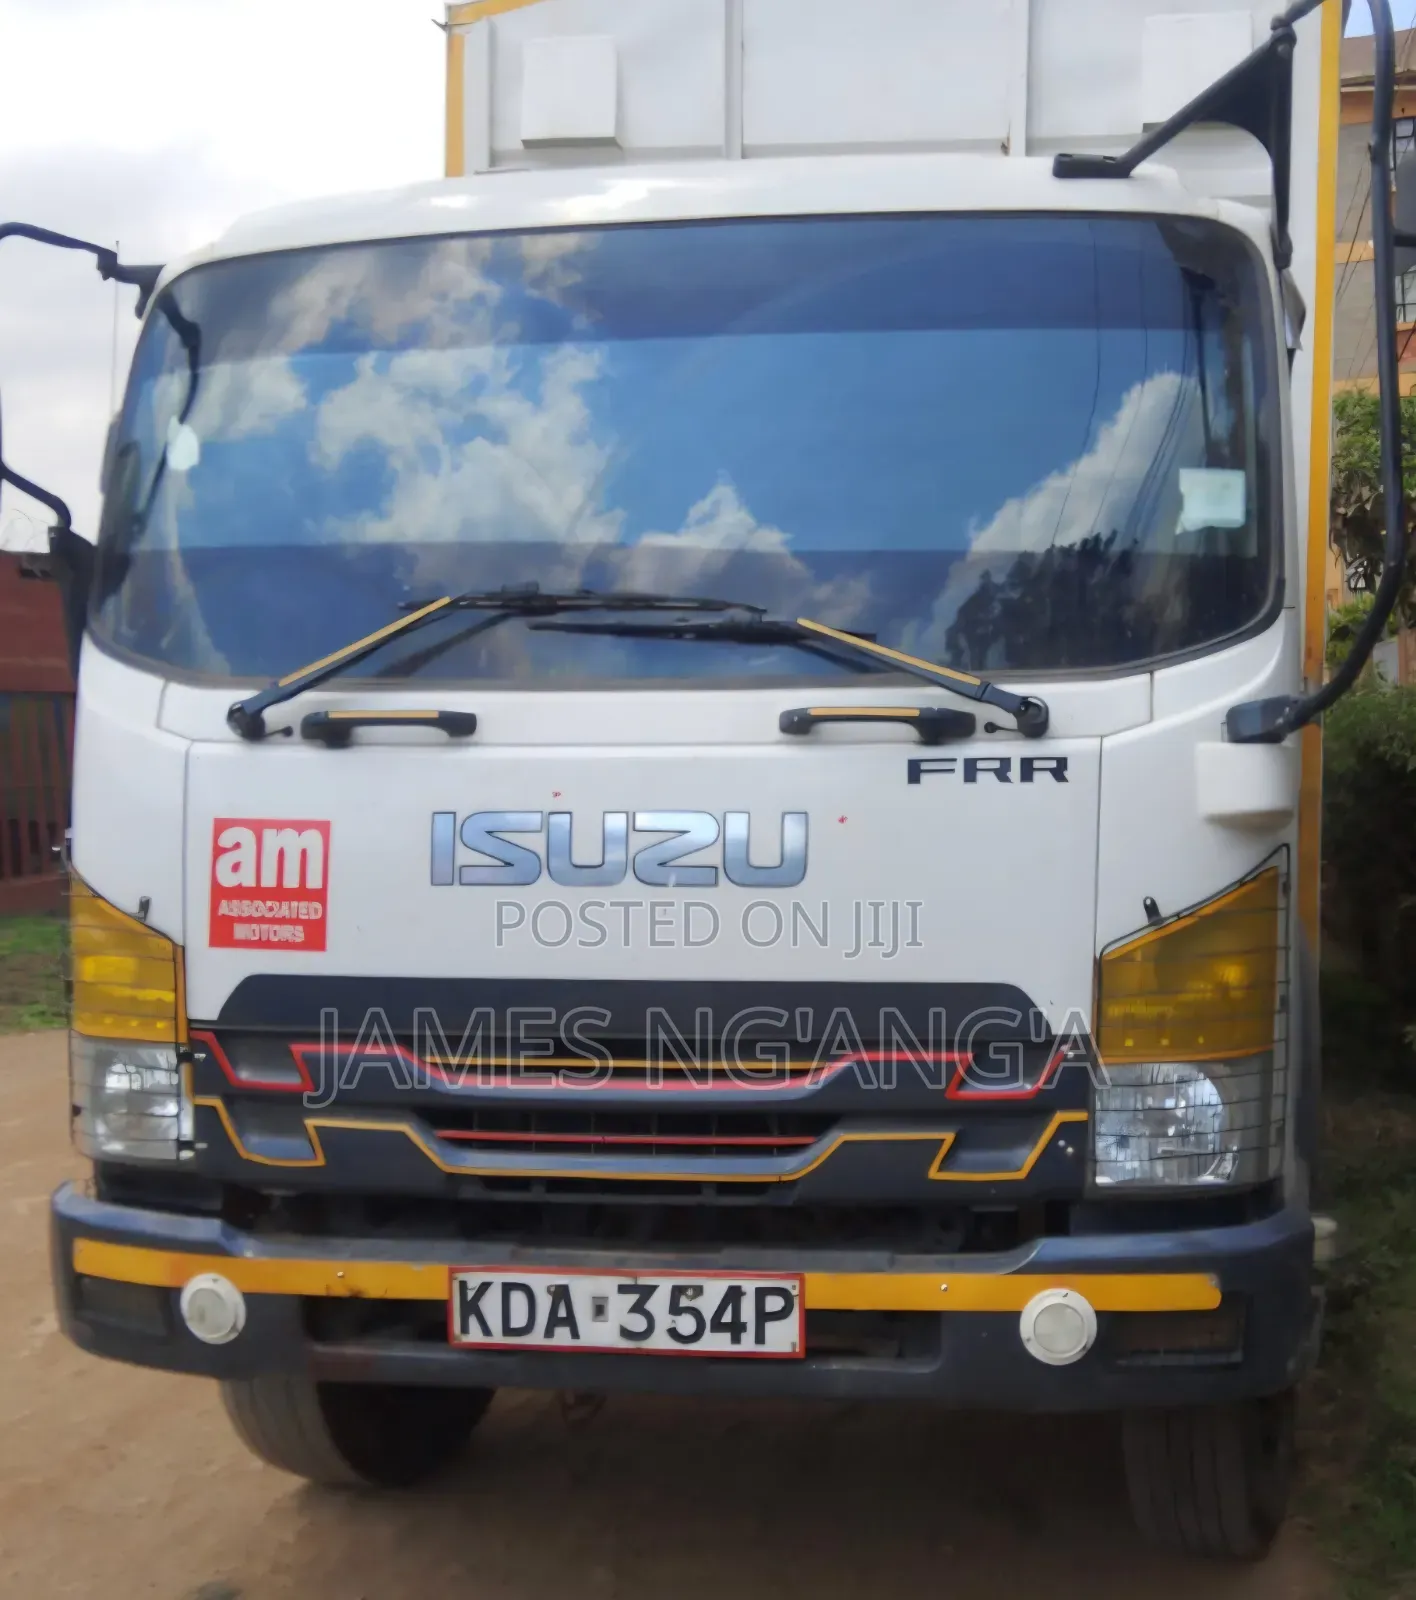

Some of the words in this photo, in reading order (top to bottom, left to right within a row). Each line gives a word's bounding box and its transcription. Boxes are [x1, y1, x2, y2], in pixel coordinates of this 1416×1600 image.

[907, 756, 1070, 785] FRR
[215, 826, 324, 889] am
[430, 810, 809, 887] ISUZU
[459, 1281, 580, 1340] KDA
[618, 1285, 795, 1345] 354P
